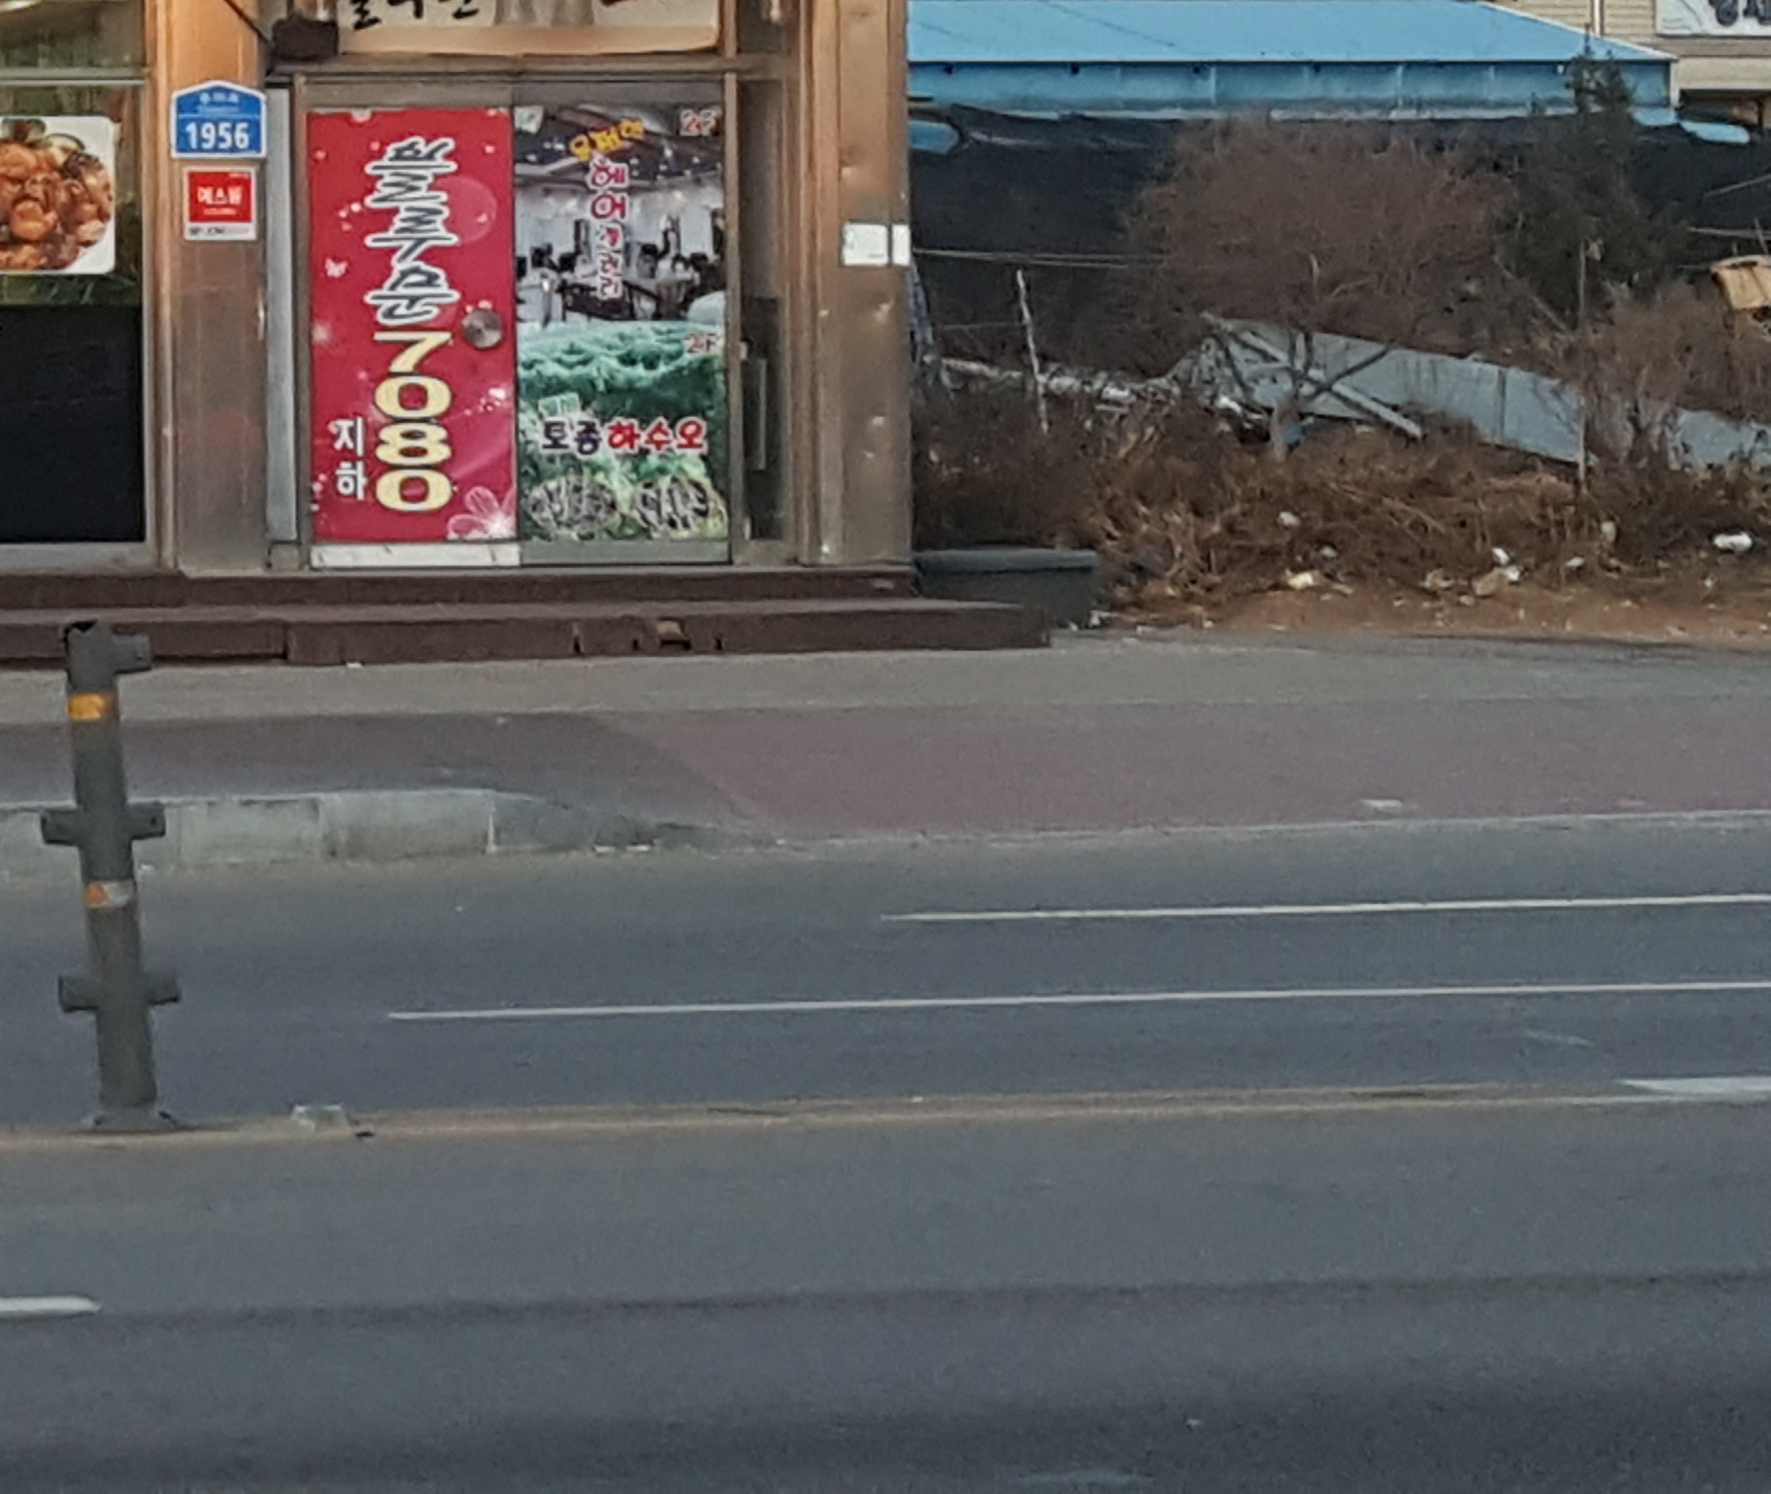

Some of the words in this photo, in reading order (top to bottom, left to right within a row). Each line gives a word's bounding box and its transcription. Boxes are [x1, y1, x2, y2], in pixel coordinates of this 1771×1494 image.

[185, 121, 251, 151] 1956
[373, 331, 454, 513] 7080
[540, 415, 709, 457] 토종하수오
[331, 416, 368, 500] 지하
